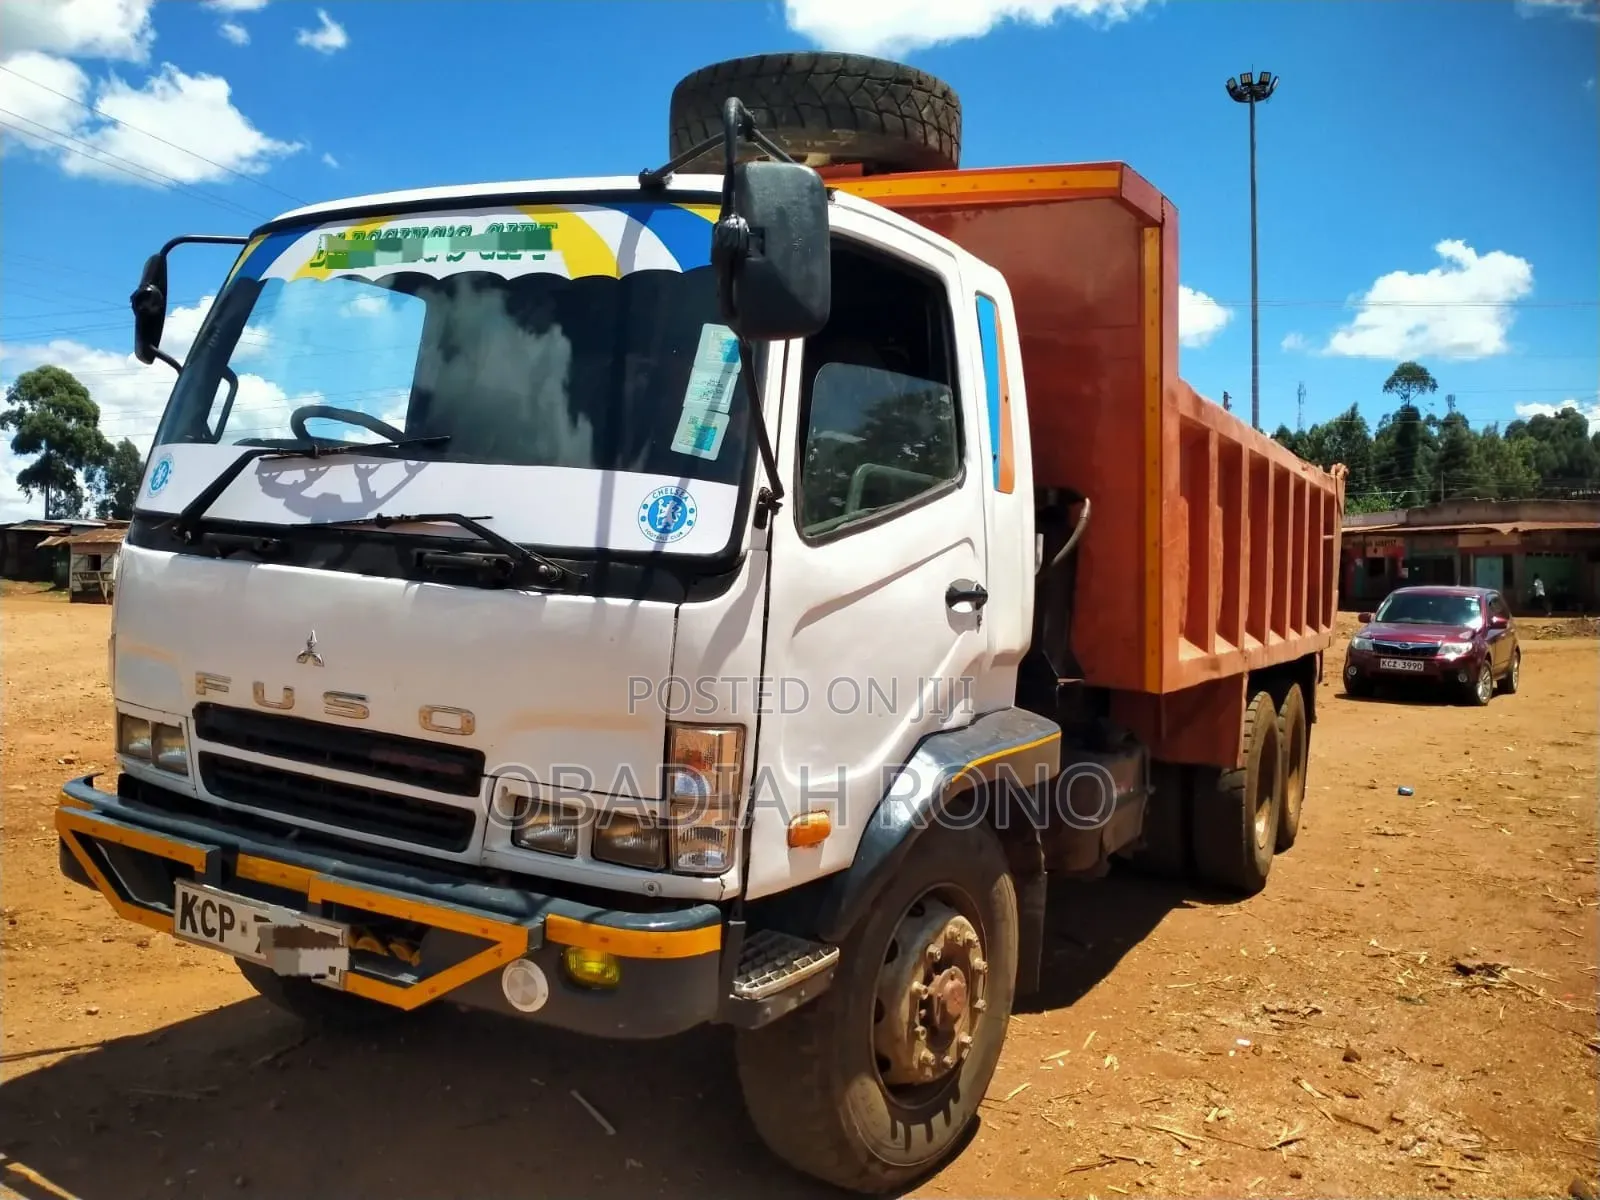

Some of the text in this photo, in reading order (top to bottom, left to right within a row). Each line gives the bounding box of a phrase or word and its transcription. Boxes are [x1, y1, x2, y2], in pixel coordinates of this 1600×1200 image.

[652, 488, 689, 501] CHELSEA
[195, 671, 476, 736] FUSO
[179, 891, 236, 943] KCP
